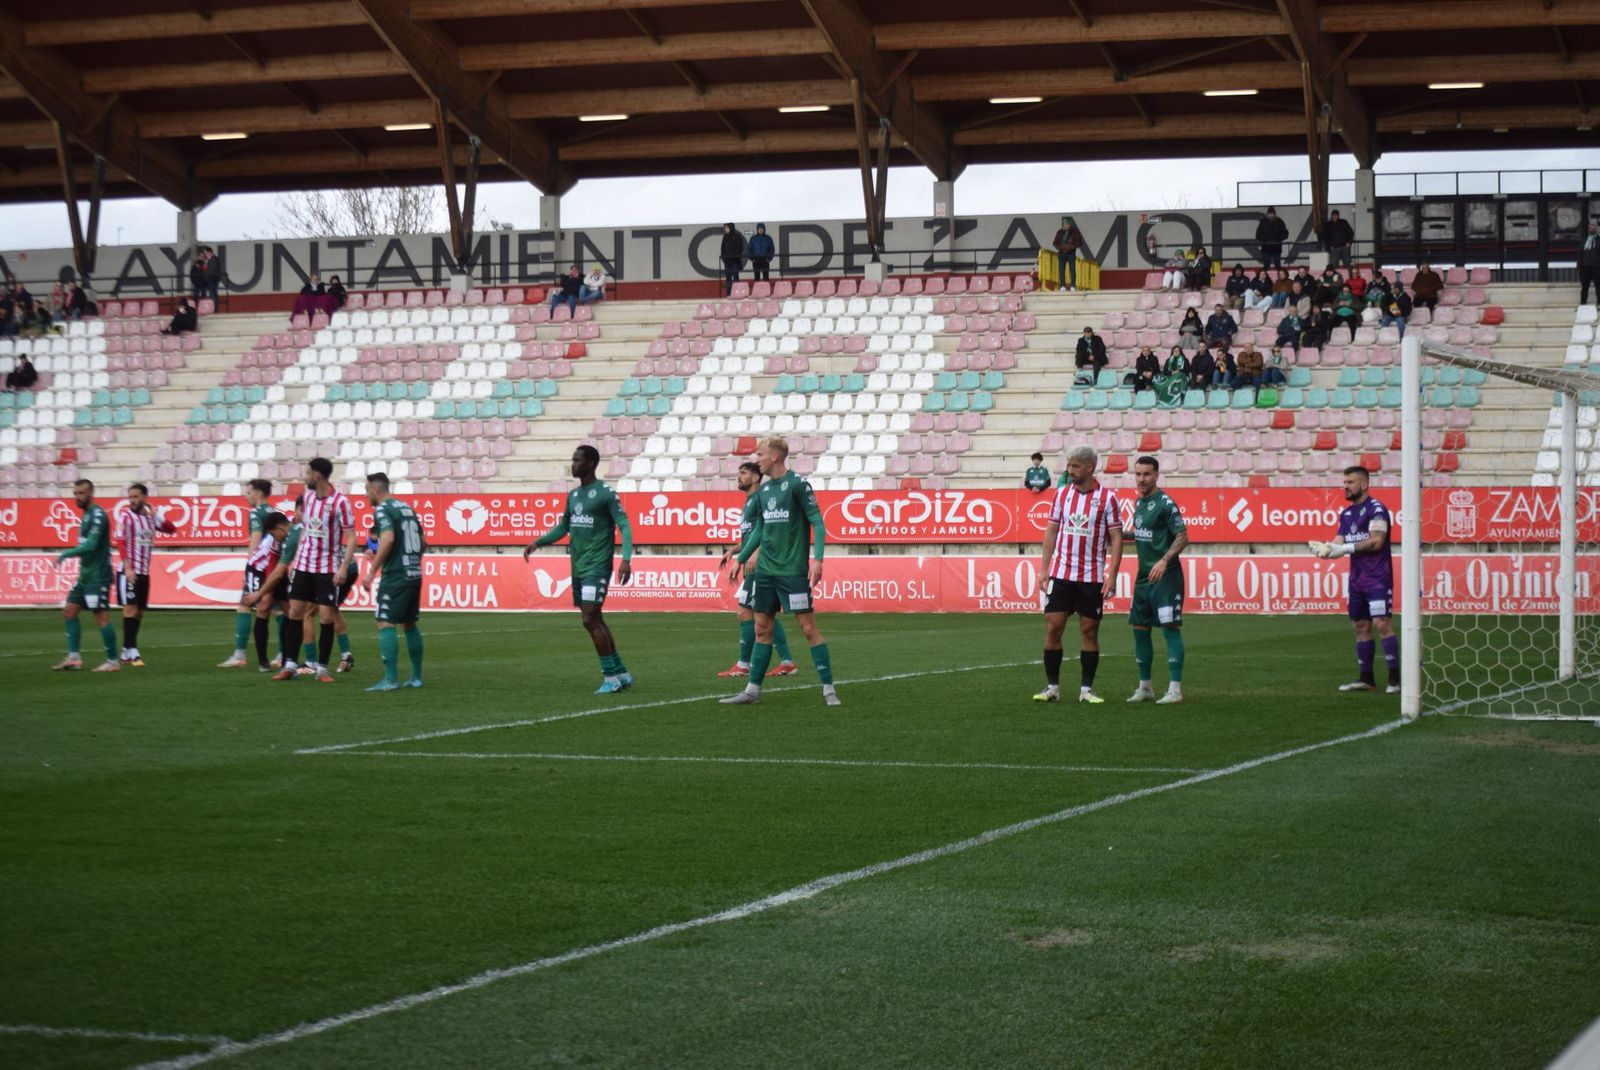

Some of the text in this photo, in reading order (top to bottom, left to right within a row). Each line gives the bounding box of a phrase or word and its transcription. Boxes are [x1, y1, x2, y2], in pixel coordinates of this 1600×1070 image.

[108, 209, 1330, 298] AYUNTAMIENTO DE ZAMORA
[489, 512, 536, 528] tres
[639, 513, 654, 526] la
[189, 529, 243, 538] JAMONES
[402, 520, 421, 553] 16
[706, 527, 729, 538] de
[840, 526, 917, 535] EMBUTIDOS
[931, 526, 993, 535] JAMONES
[425, 562, 498, 576] DENTAL
[967, 559, 1003, 599] La
[1188, 559, 1226, 599] La
[428, 583, 499, 608] PAULA
[907, 581, 935, 599] S.L.
[979, 600, 1037, 610] El Correo
[1200, 600, 1340, 613] El Correo de Zamora
[1428, 600, 1440, 610] El
[1444, 600, 1489, 611] Correo
[1501, 600, 1518, 610] de
